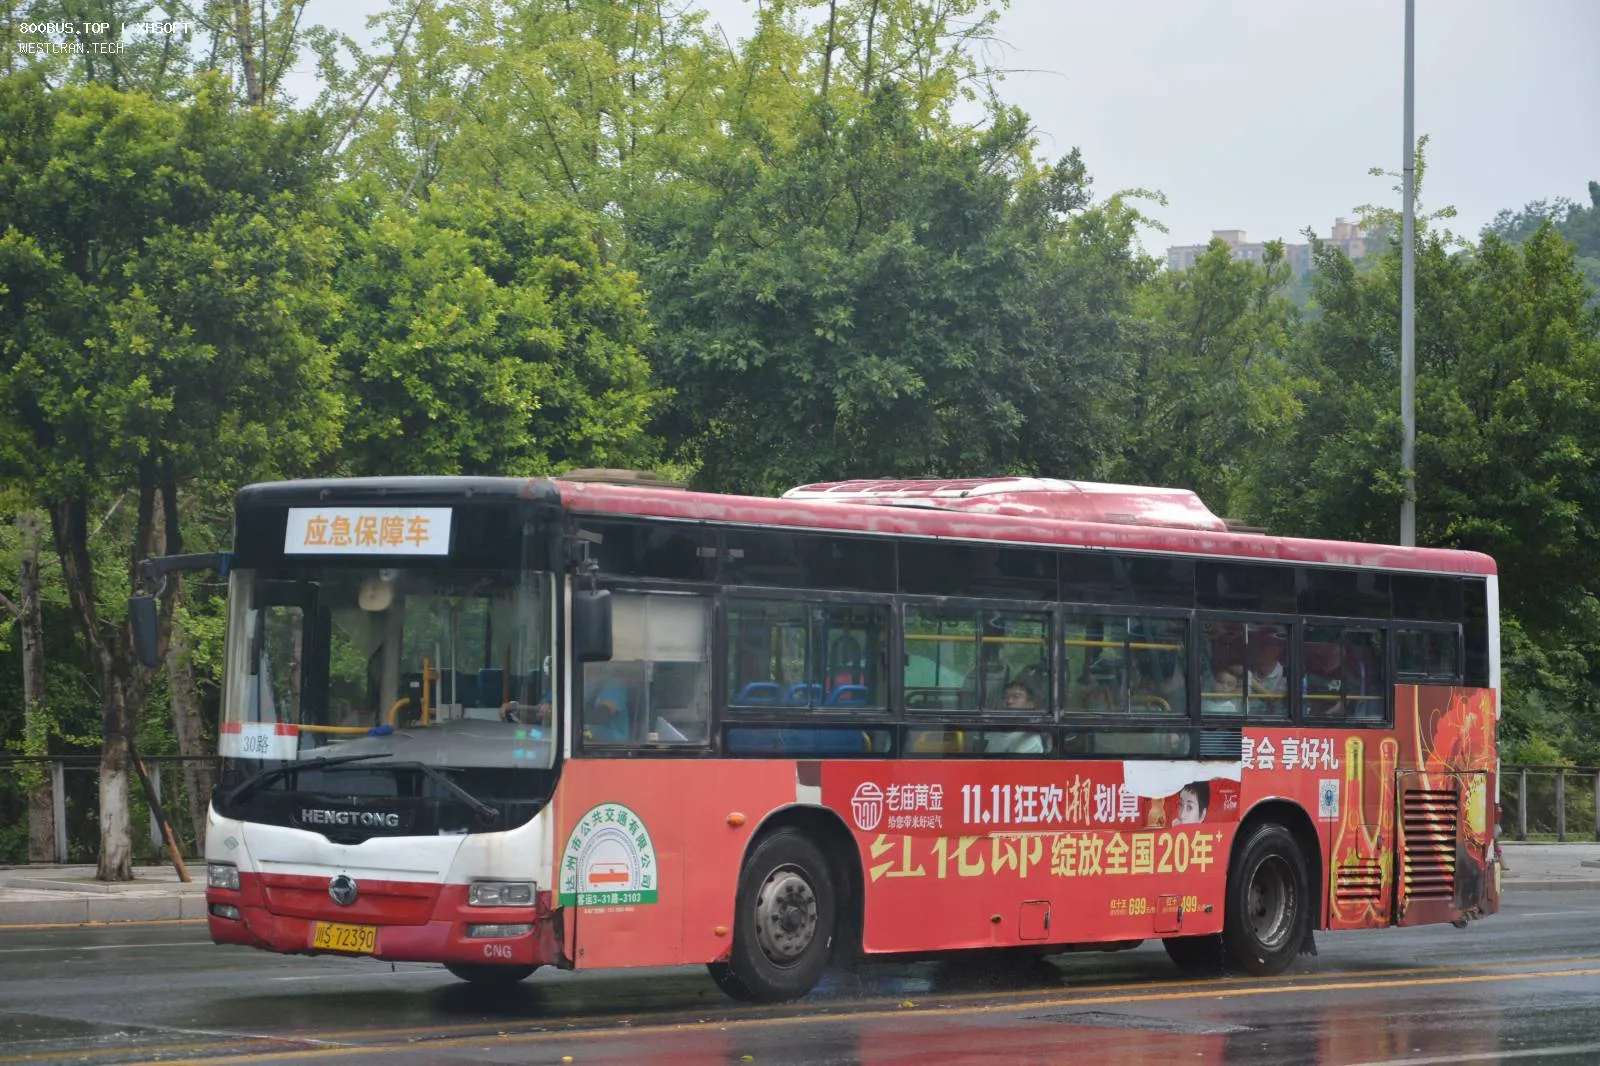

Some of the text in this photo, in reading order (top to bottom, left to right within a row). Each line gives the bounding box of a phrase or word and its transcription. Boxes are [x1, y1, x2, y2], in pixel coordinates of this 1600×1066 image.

[304, 515, 432, 547] 应急保障车
[243, 735, 269, 753] 30路
[1281, 737, 1339, 770] 享好礼
[886, 784, 944, 811] 老庙黄金
[301, 808, 399, 827] HENGTONG
[483, 943, 513, 958] CNG
